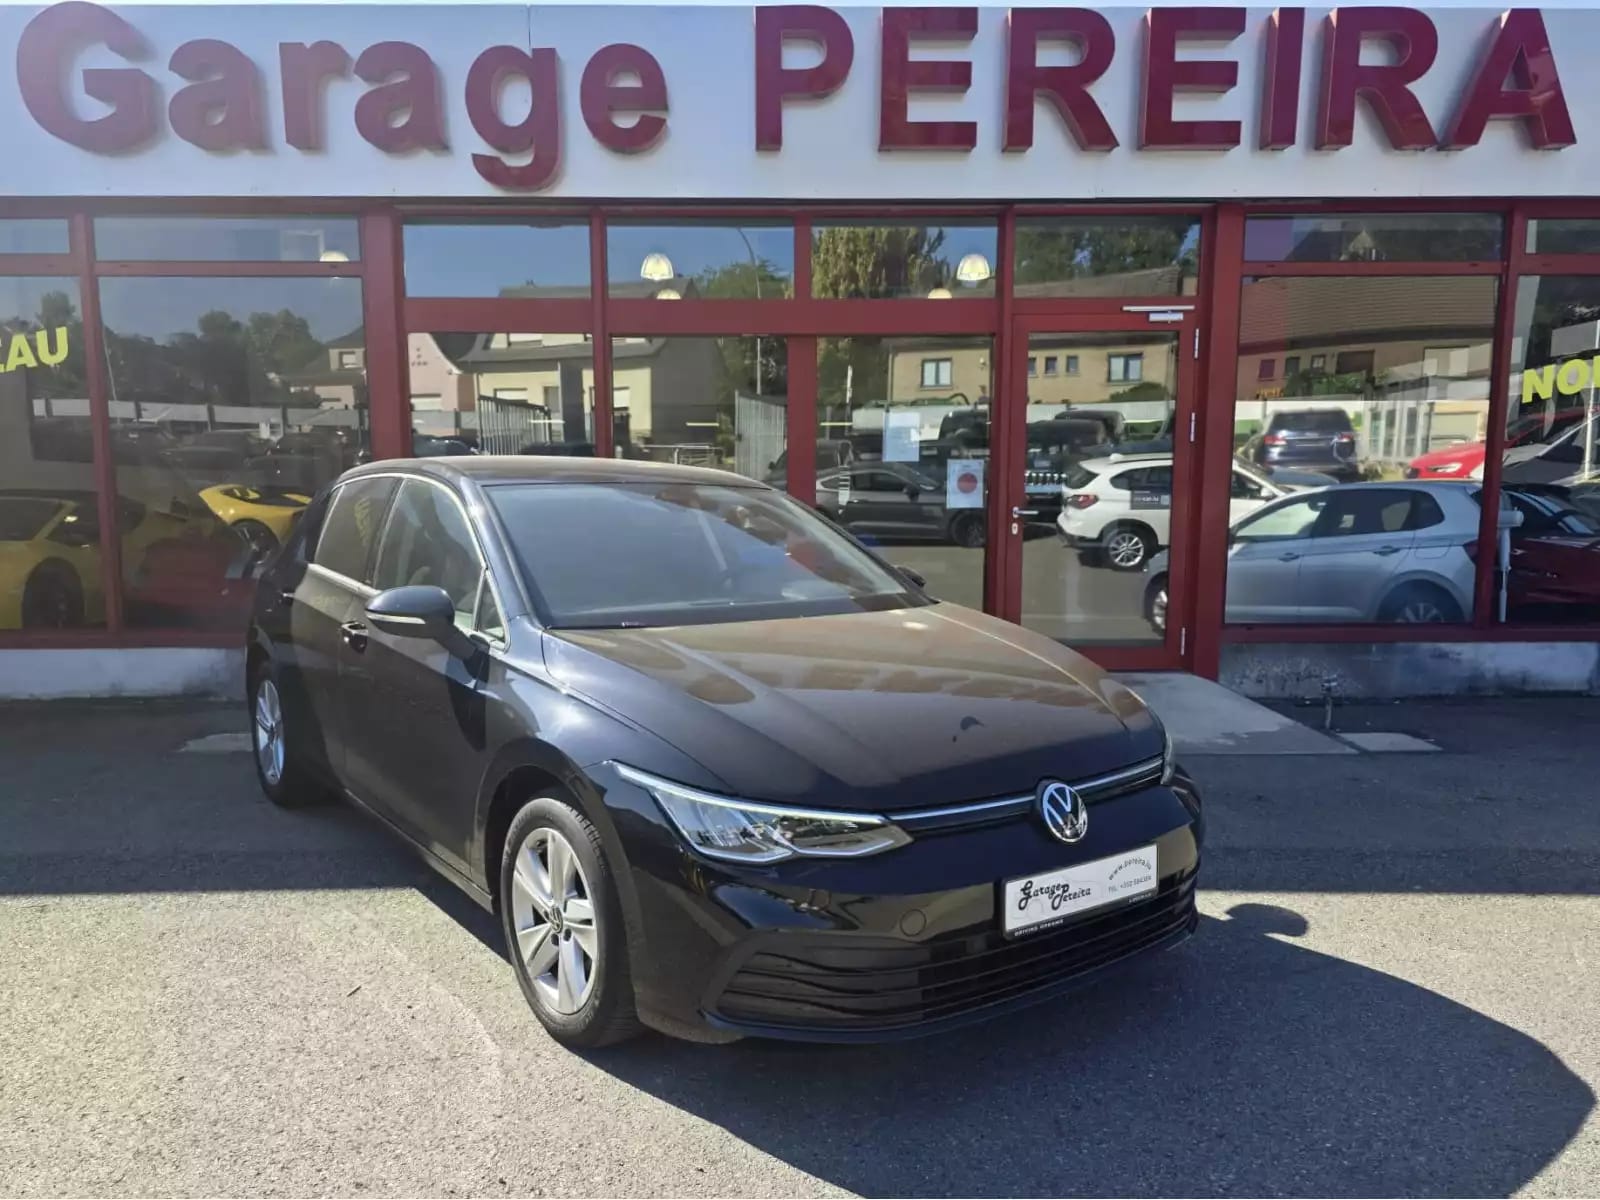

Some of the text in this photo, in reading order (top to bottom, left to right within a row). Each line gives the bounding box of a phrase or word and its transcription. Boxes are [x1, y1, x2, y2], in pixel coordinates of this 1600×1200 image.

[16, 1, 1578, 191] Garage PEREIRA
[0, 326, 69, 373] AU
[1018, 880, 1061, 910] Garage
[1051, 883, 1091, 910] Pereira
